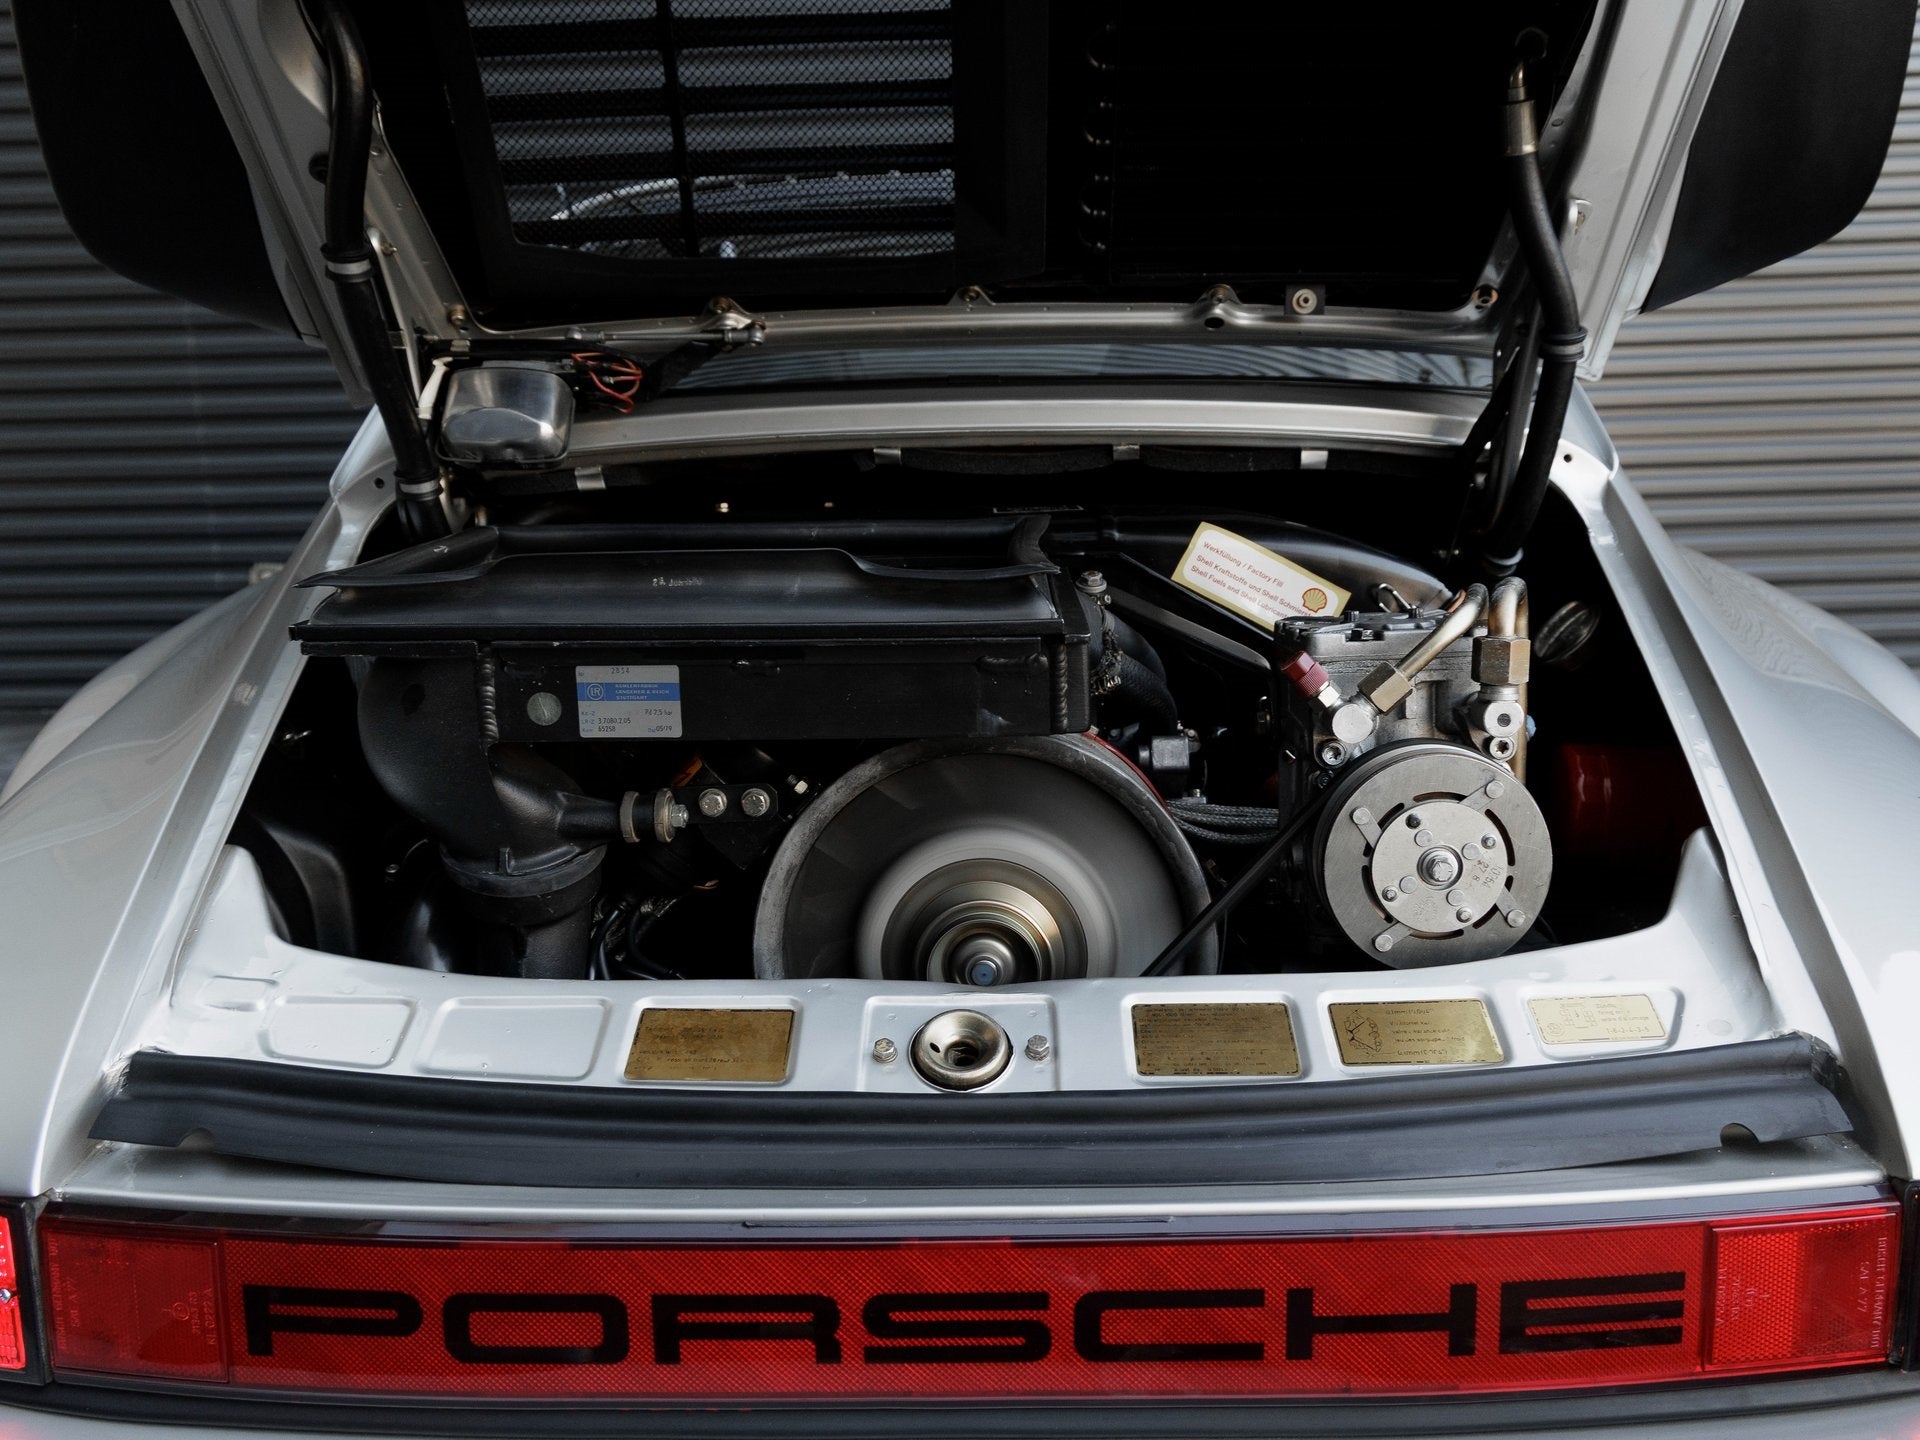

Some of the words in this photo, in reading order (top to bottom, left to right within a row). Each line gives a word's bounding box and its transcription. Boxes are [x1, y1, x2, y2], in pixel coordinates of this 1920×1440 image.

[1191, 565, 1208, 578] Shell
[1208, 573, 1227, 588] Fuels
[1227, 584, 1240, 594] and
[1240, 590, 1257, 603] Shell
[1196, 554, 1213, 568] Shell
[1213, 563, 1248, 586] Kraftstoffe
[1248, 583, 1261, 593] und
[1261, 589, 1279, 602] Shell
[1247, 564, 1272, 583] Factory
[1272, 578, 1284, 588] Fill
[242, 1271, 1686, 1365] PORSCHE
